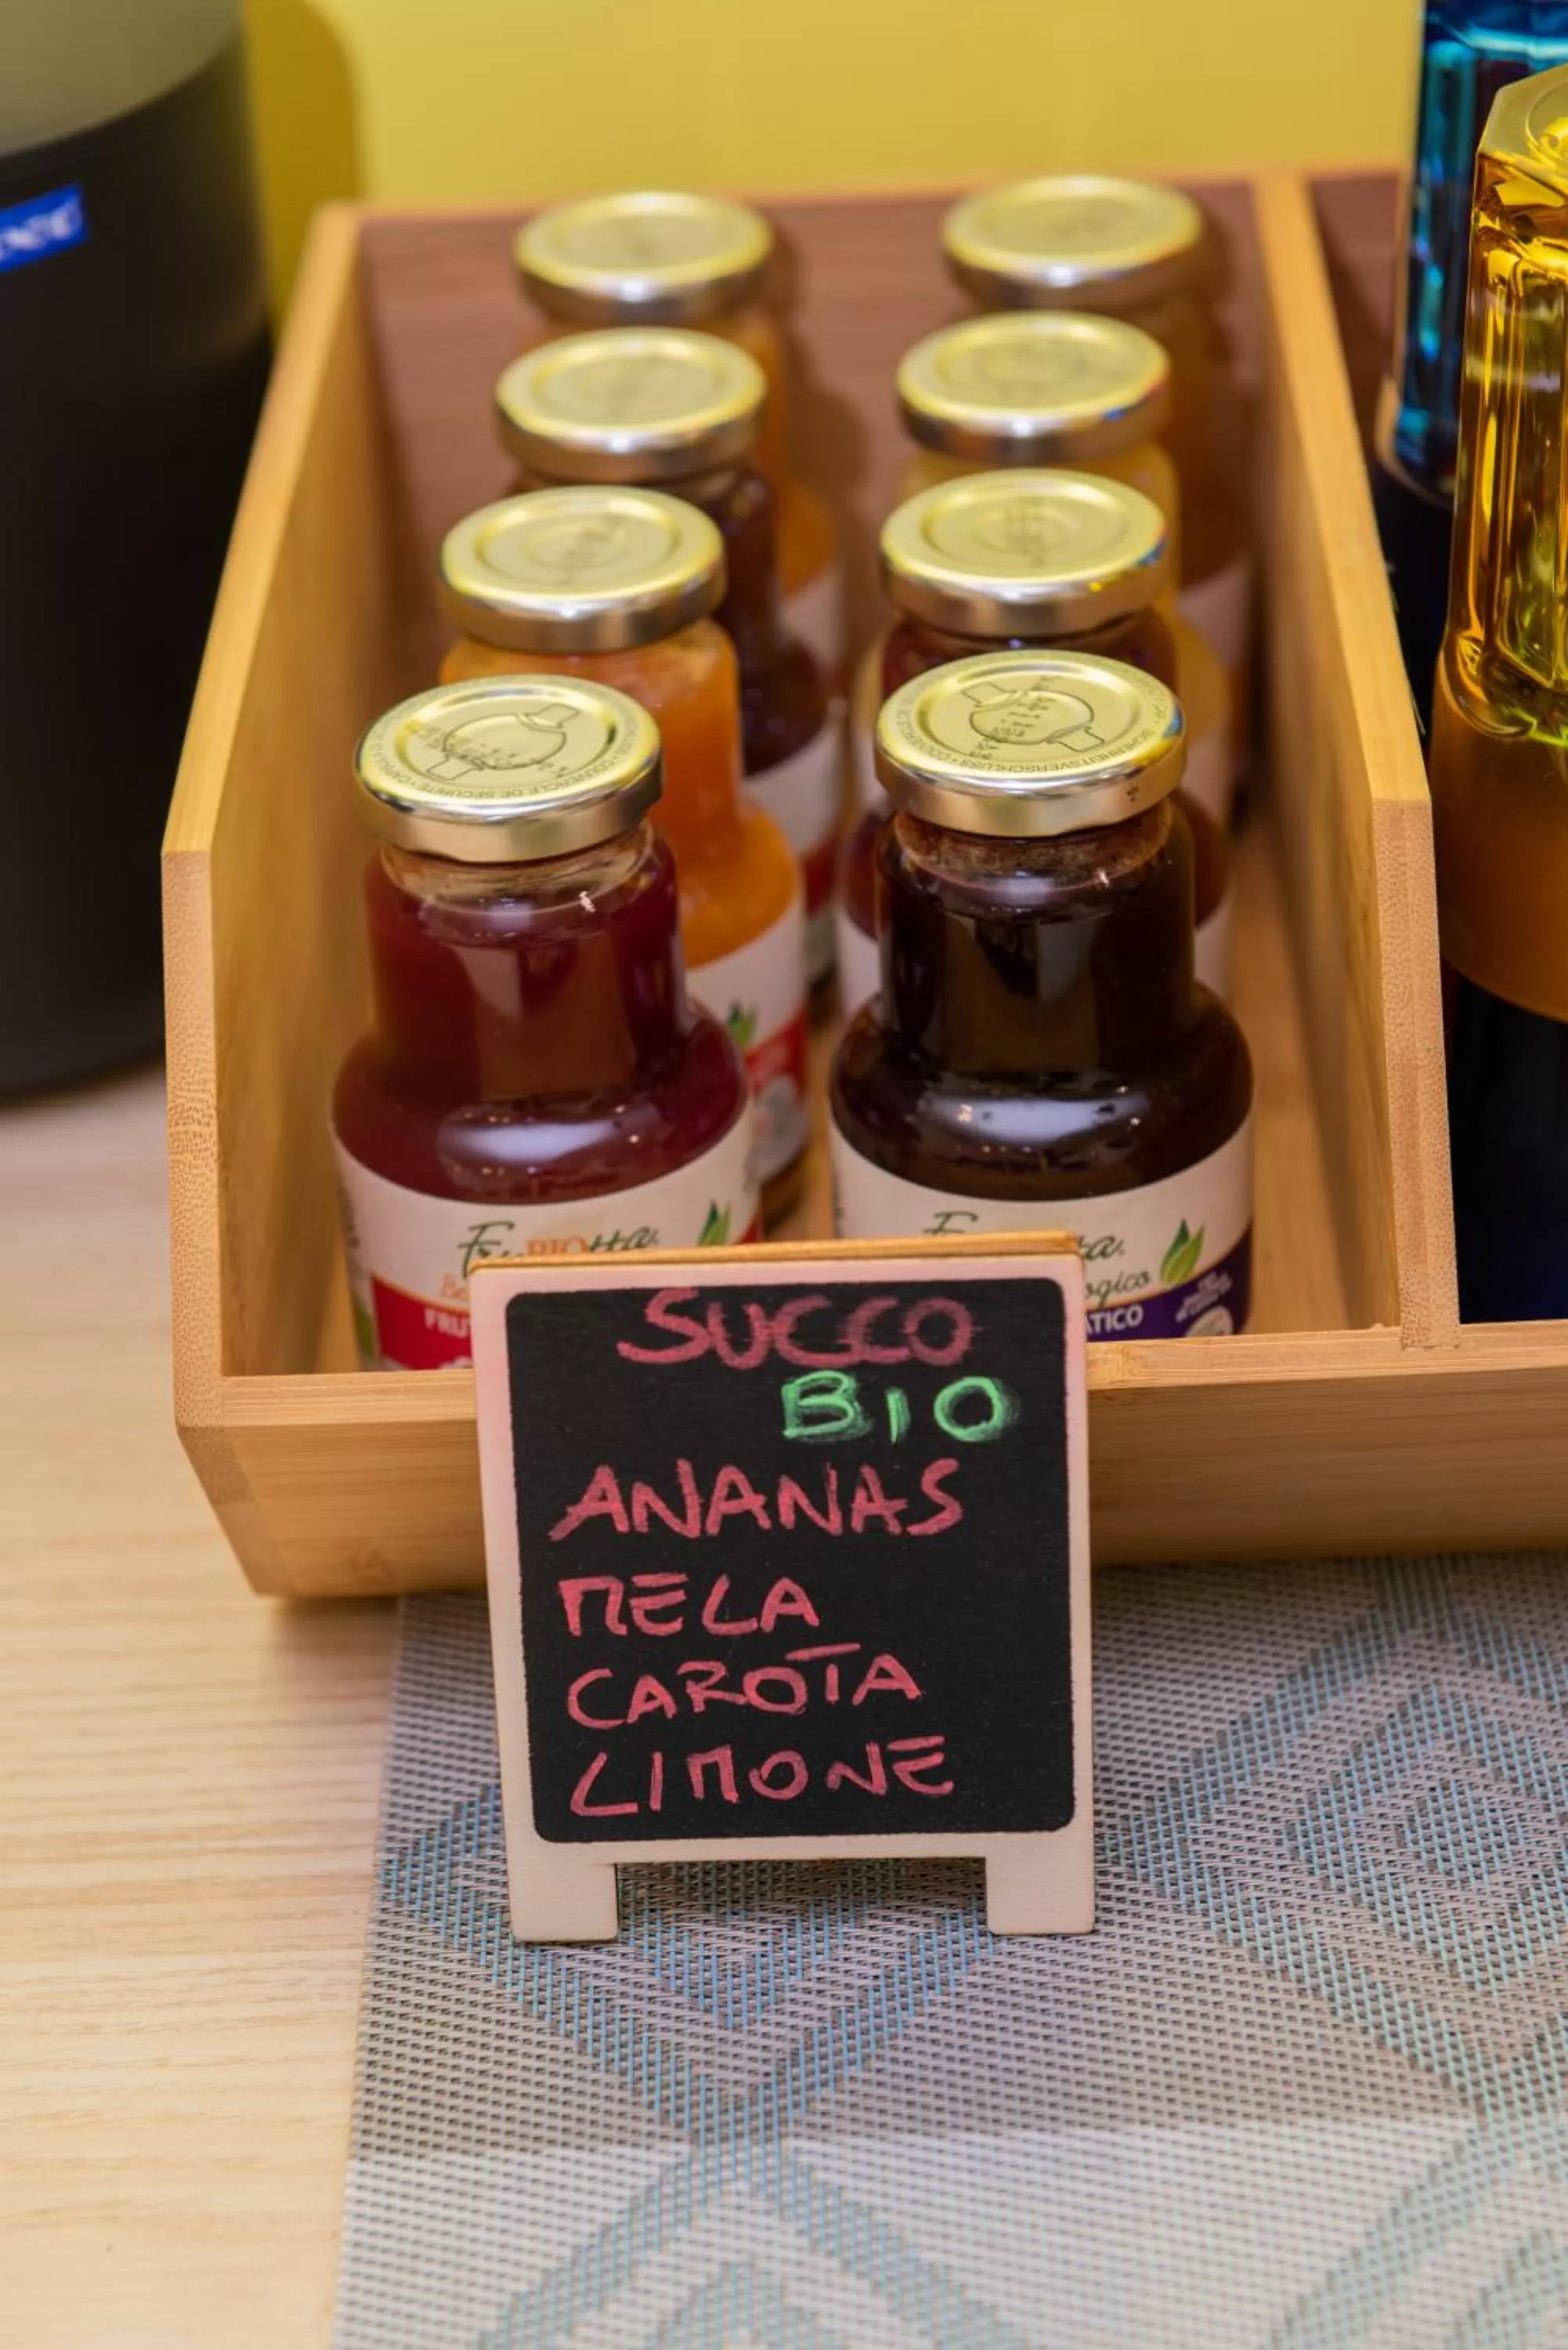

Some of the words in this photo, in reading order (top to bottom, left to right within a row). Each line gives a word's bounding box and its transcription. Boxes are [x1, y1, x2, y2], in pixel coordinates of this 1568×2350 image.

[424, 1307, 471, 1340] FRU
[616, 1286, 975, 1369] SUCCO
[781, 1369, 1012, 1443] BIO
[550, 1458, 964, 1542] ANANAS
[557, 1572, 820, 1638] MELA
[566, 1643, 923, 1729] CAROTA
[569, 1735, 954, 1817] LIMONE
